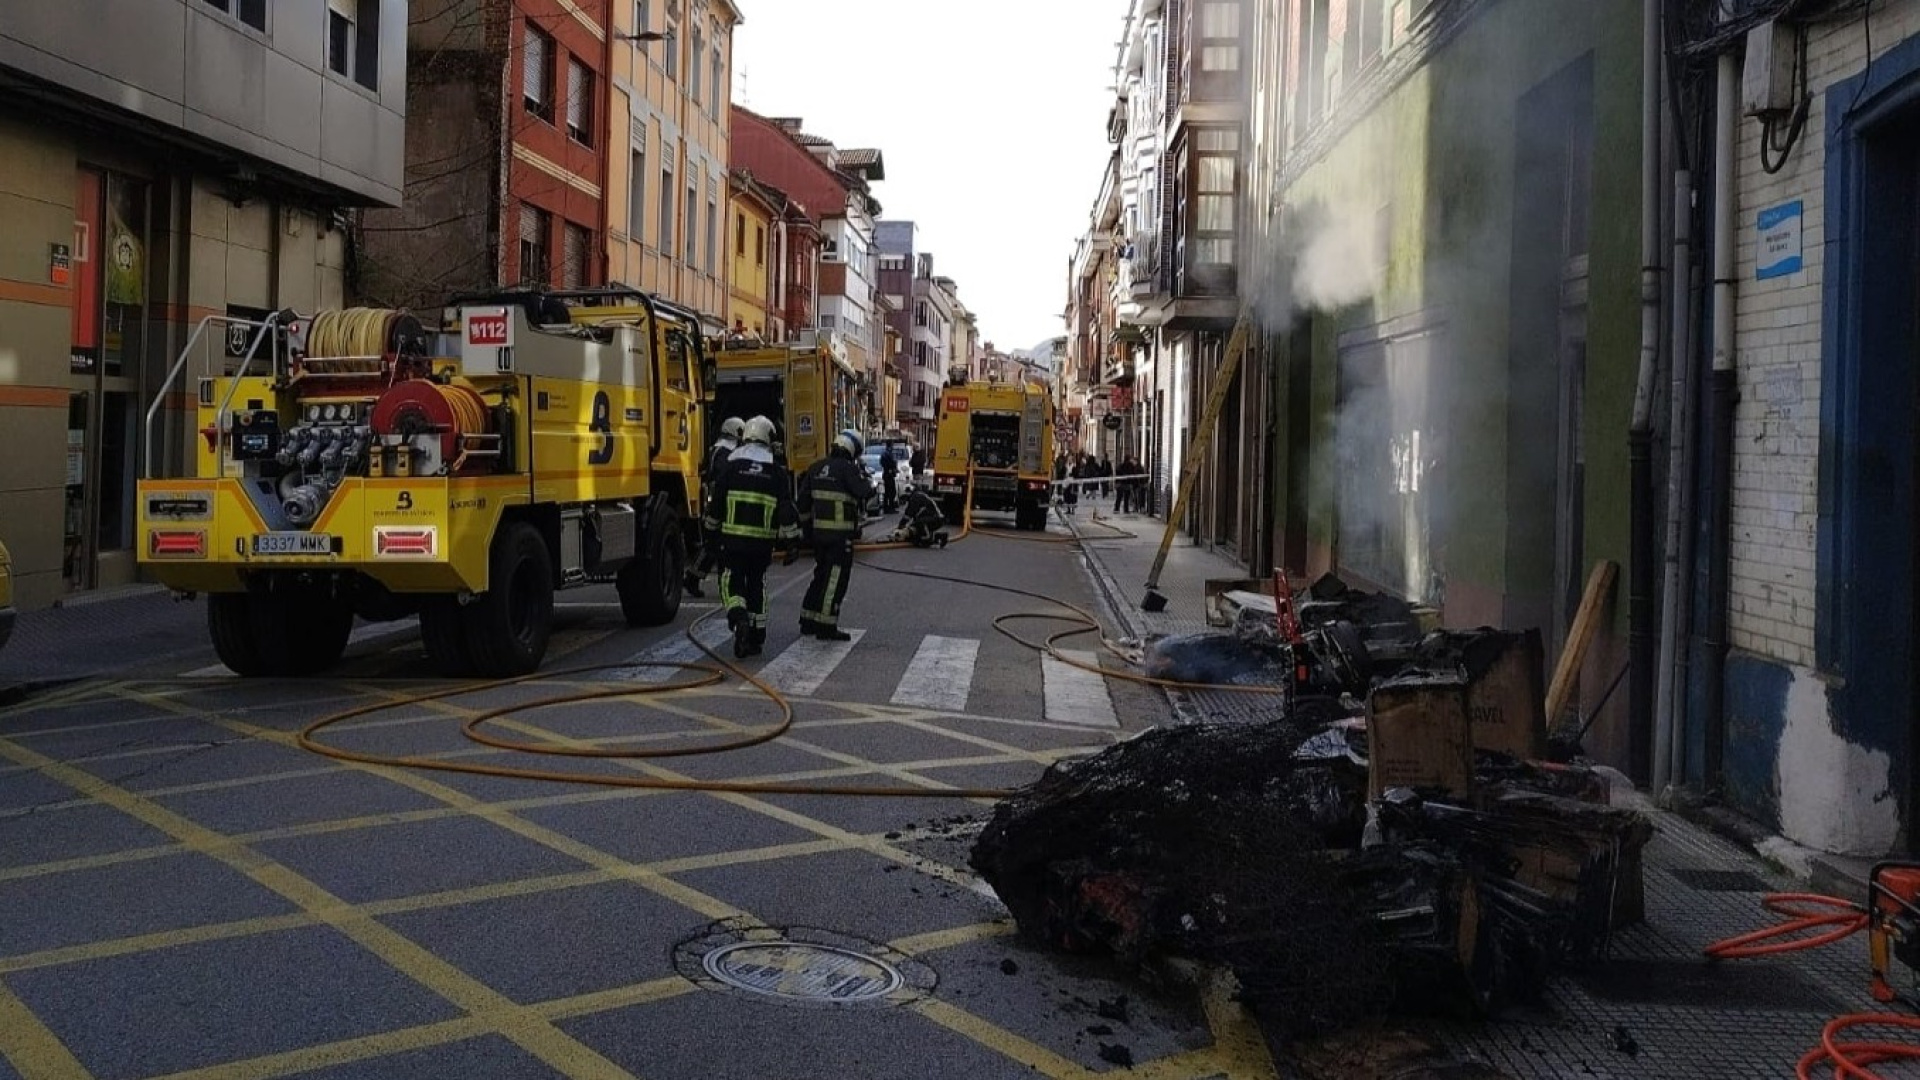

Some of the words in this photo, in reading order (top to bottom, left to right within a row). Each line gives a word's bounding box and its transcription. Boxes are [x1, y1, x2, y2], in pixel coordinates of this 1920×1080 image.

[480, 322, 505, 338] 112
[261, 536, 295, 551] 3337
[299, 536, 325, 551] MMK
